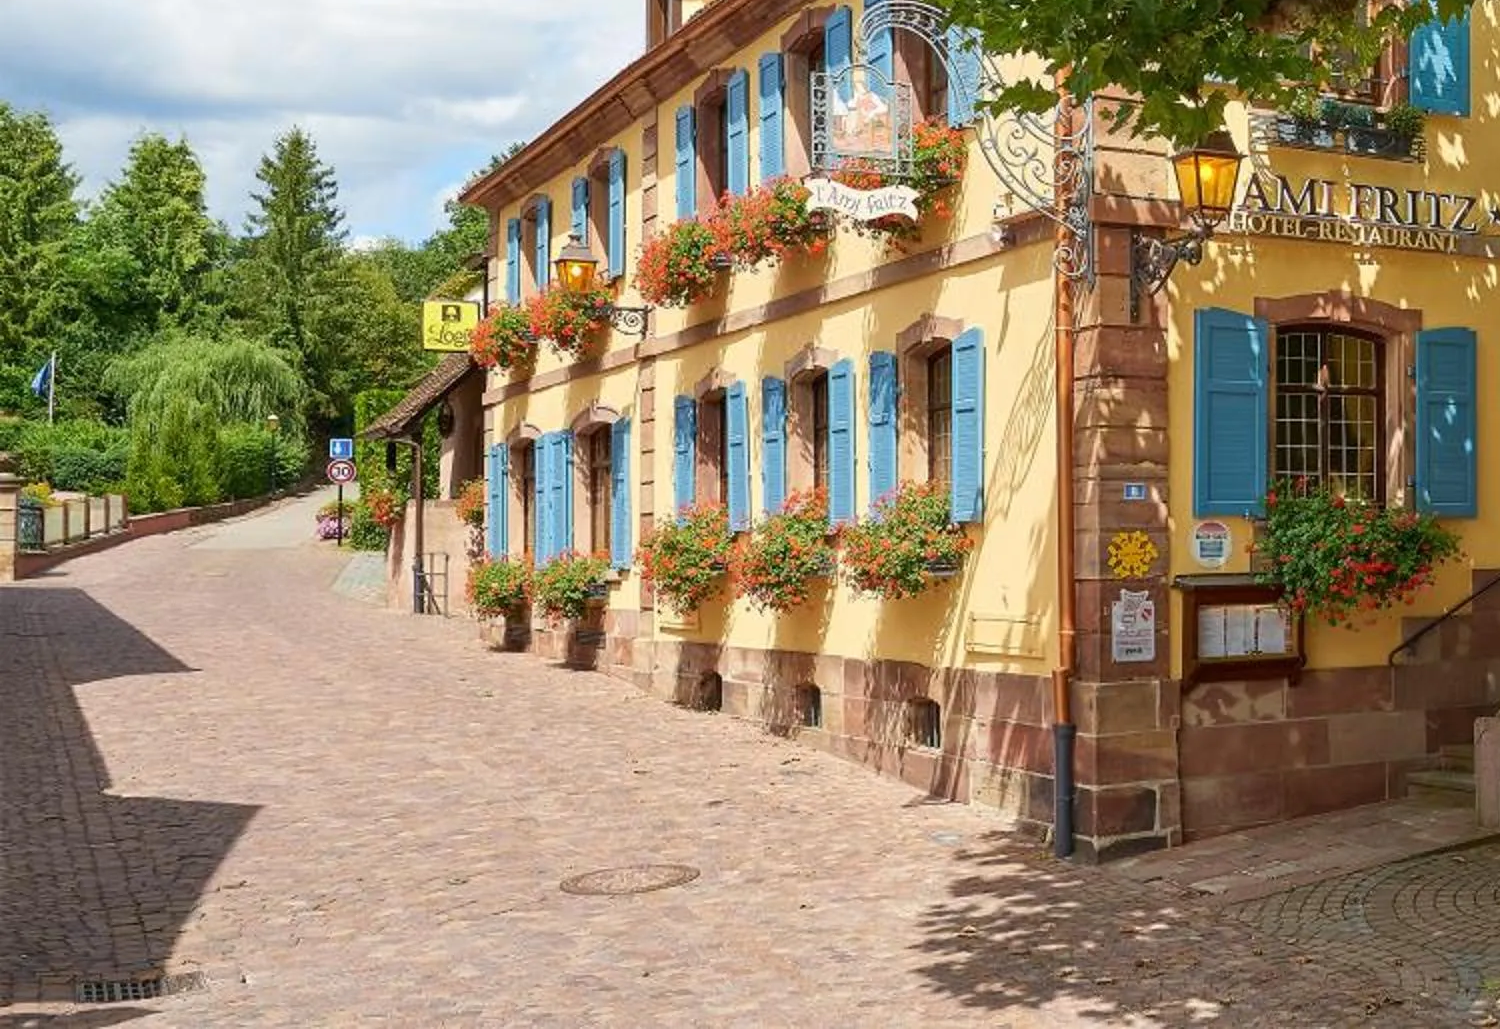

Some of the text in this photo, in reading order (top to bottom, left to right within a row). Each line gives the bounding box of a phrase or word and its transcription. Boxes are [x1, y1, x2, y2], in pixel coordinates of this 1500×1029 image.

[1237, 172, 1480, 236] AMI FRITZ
[333, 466, 350, 477] 30
